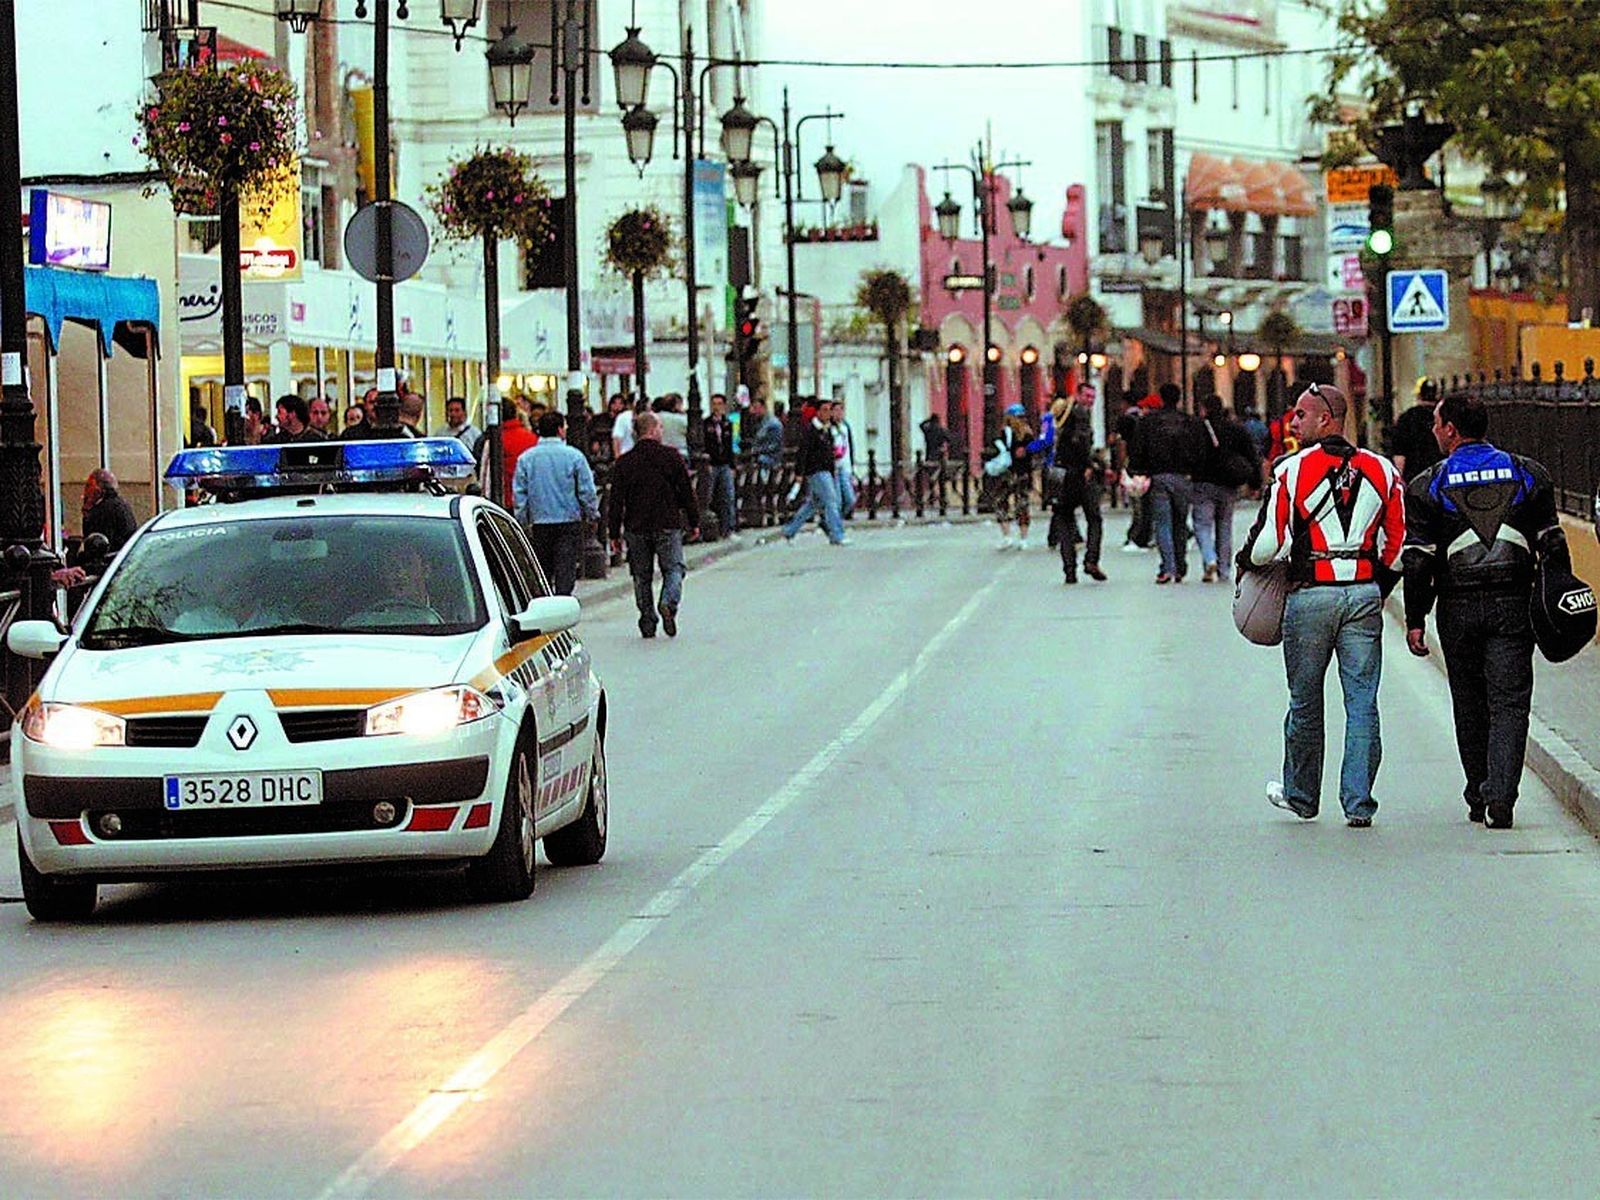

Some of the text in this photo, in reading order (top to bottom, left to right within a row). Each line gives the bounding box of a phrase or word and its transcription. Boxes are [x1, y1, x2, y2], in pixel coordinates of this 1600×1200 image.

[1566, 591, 1595, 610] SHO
[184, 779, 252, 804] 3528
[261, 776, 312, 802] DHC
